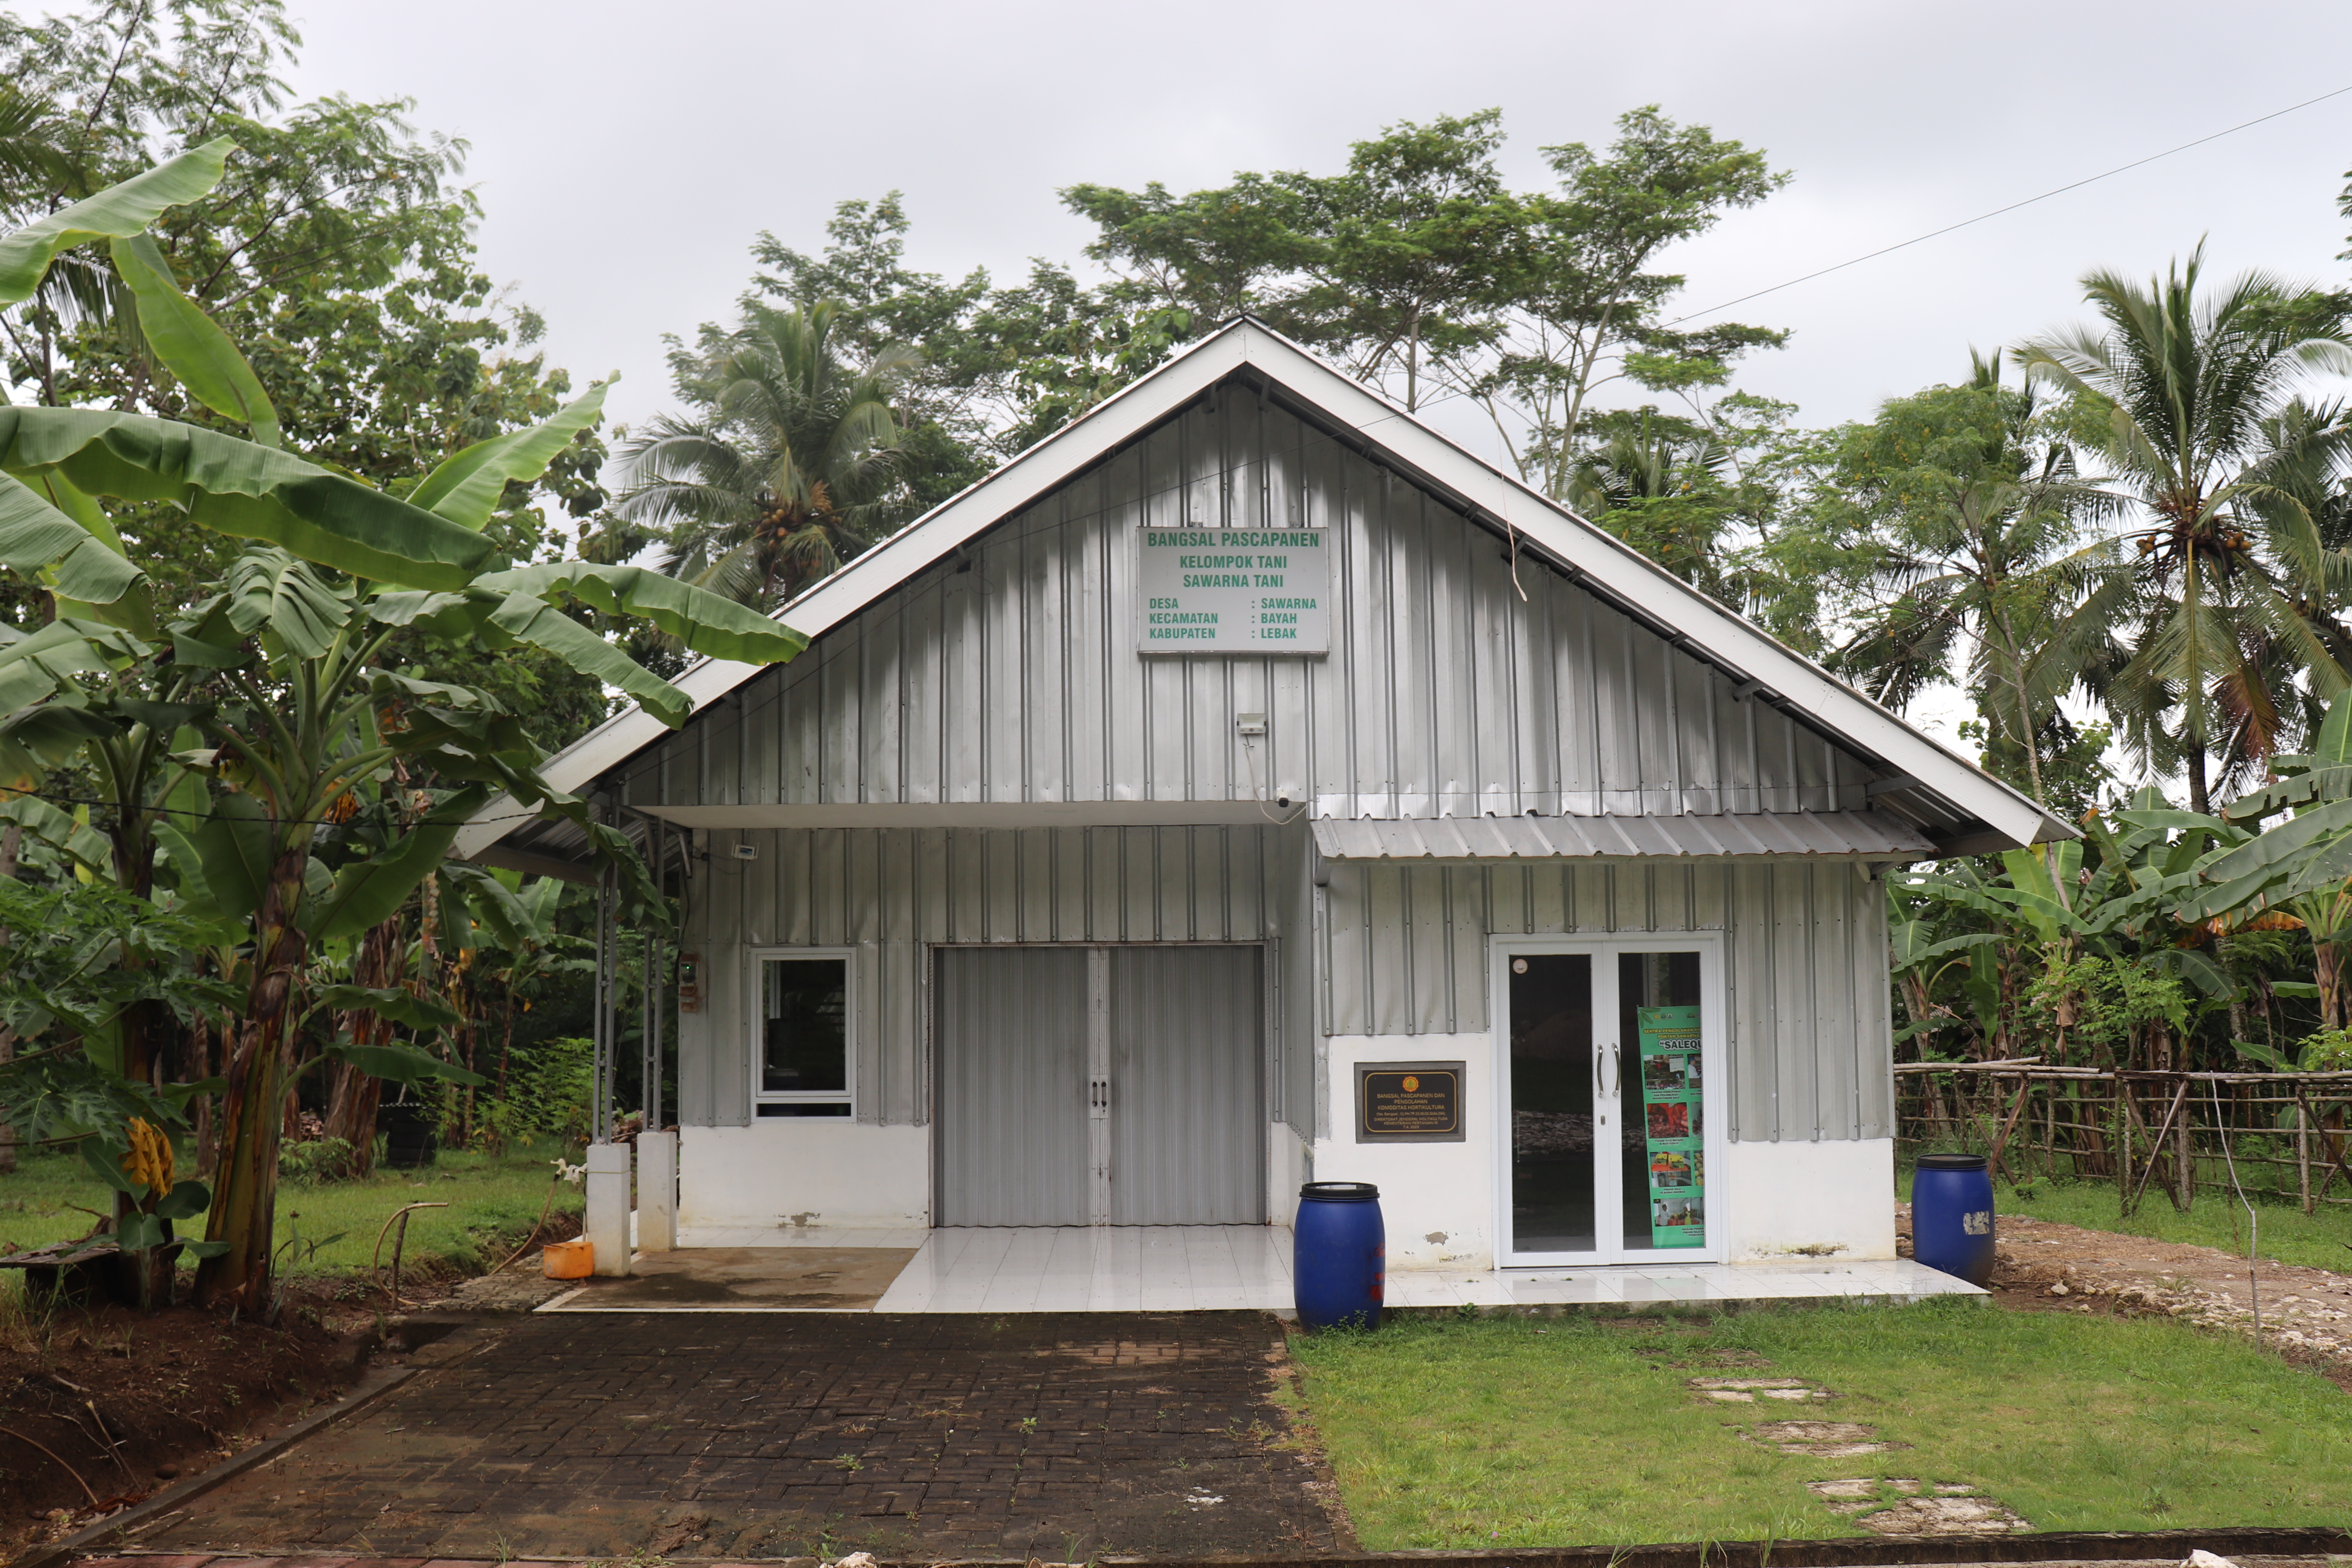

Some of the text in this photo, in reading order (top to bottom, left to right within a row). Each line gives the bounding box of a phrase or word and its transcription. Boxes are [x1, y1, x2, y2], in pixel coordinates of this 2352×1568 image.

[1148, 532, 1319, 547] BANGSAL PASCAPANEN
[1180, 555, 1287, 568] KELOMPOK TANI
[1183, 574, 1284, 588] SAWARNA TANI
[1150, 598, 1179, 609] DESA
[1261, 598, 1317, 609] SAWARNA
[1150, 613, 1219, 624] KECAMATAN
[1261, 613, 1297, 624] BAYAH
[1150, 628, 1216, 639] KABUPATEN
[1261, 628, 1297, 639] LEBAK
